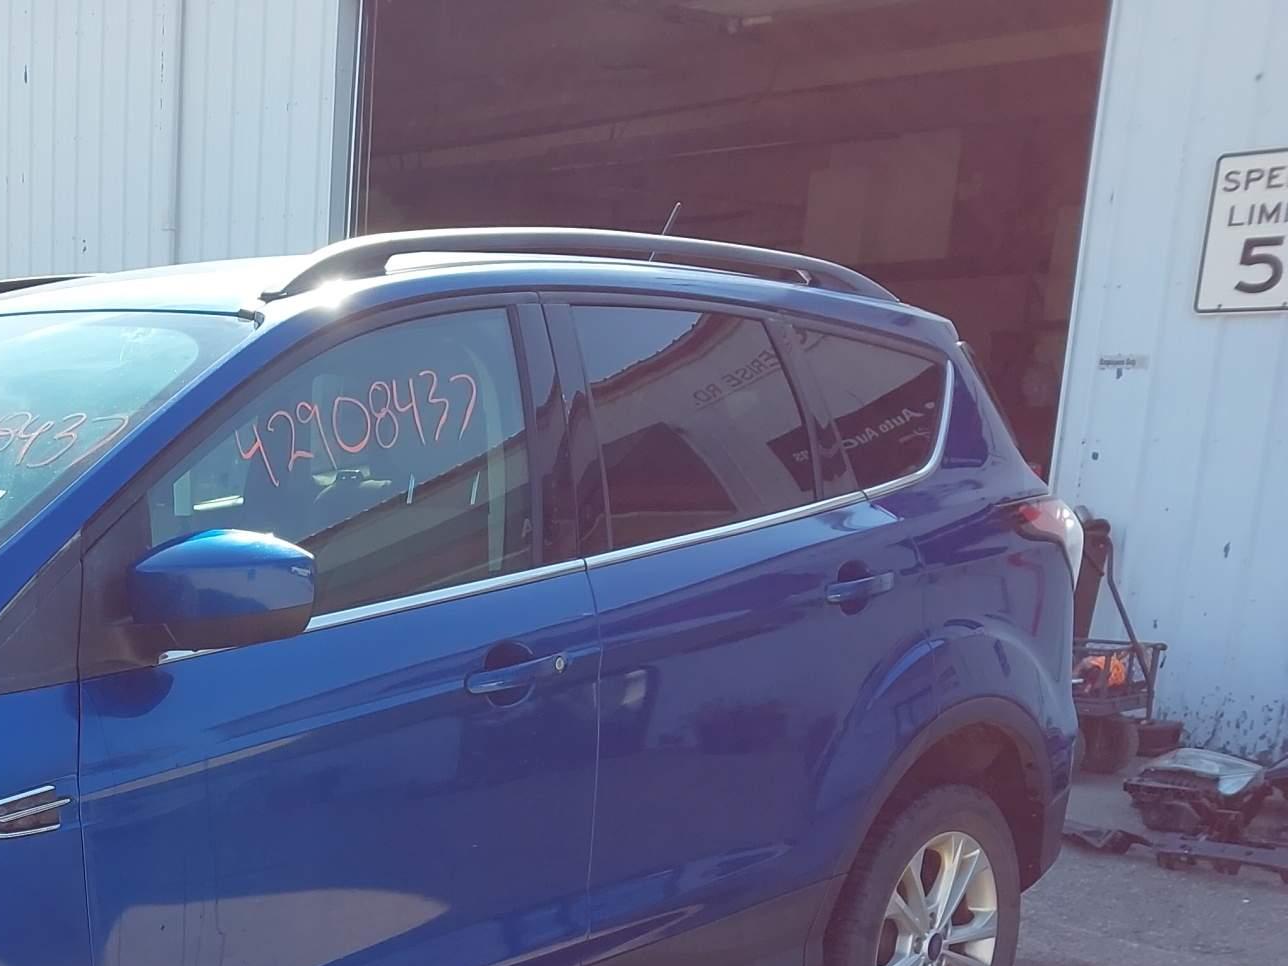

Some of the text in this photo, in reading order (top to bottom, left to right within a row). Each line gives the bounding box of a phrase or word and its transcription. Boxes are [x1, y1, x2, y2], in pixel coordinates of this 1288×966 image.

[1222, 166, 1288, 192] SPE
[1234, 235, 1285, 294] 5
[235, 370, 477, 487] 42908437
